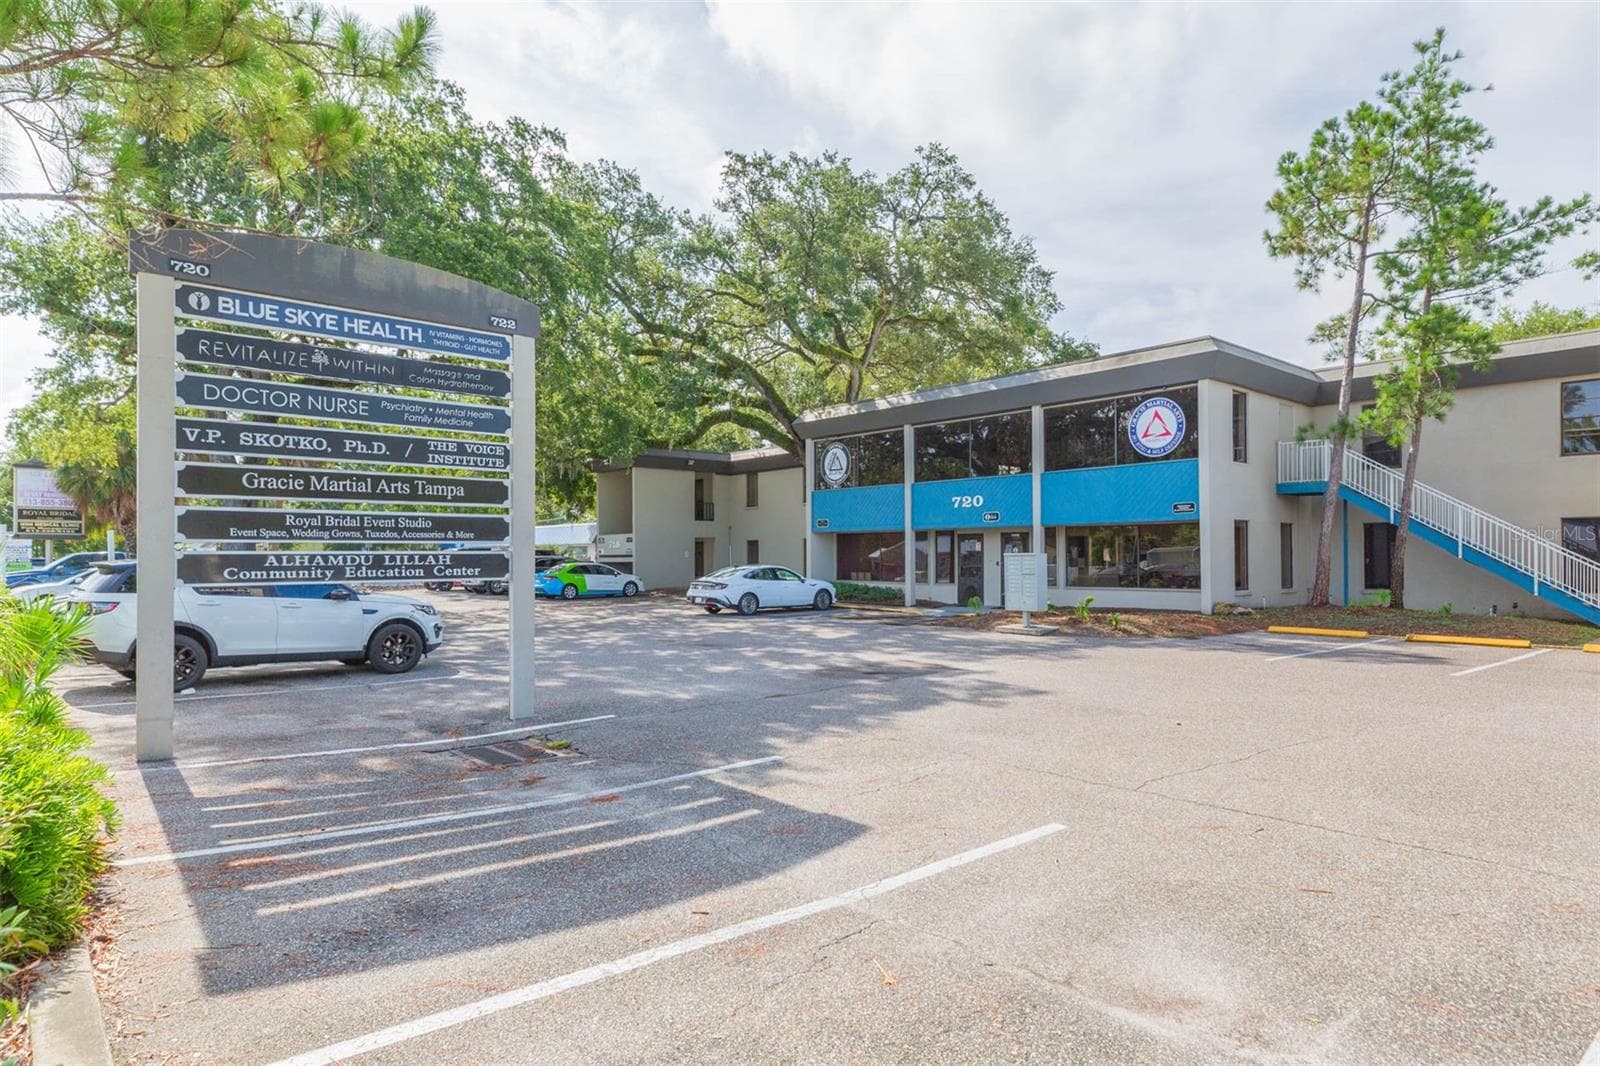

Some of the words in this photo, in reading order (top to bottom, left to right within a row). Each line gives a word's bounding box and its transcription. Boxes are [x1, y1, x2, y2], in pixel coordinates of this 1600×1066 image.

[170, 259, 210, 277] 720
[217, 296, 280, 321] BLUE
[284, 307, 339, 331] SKYE
[491, 316, 517, 330] 722
[433, 339, 460, 349] THYROID
[478, 345, 501, 354] HEALTH
[436, 331, 465, 342] VITAMINS
[469, 336, 503, 347] HORMONES
[198, 339, 308, 368] REVITALIZE
[332, 357, 395, 376] WITHIN
[423, 366, 462, 380] Massage
[463, 373, 481, 381] and
[408, 374, 436, 385] Colon
[437, 378, 494, 392] Hydrotherapy
[203, 383, 301, 409] DOCTOR
[308, 394, 369, 416] NURSE
[380, 400, 426, 413] Psychiatry
[435, 407, 465, 417] Mental
[466, 410, 494, 420] Health
[403, 412, 433, 425] Family
[433, 416, 474, 427] Medicine
[182, 427, 226, 444] V.P.
[239, 431, 332, 453] SKOTKO,
[343, 439, 390, 455] Ph.D.
[404, 443, 414, 458] /
[427, 440, 457, 452] THE
[464, 443, 505, 456] VOICE
[427, 453, 505, 468] INSTITUTE
[241, 472, 304, 490] Gracie
[309, 475, 372, 493] Martial
[376, 479, 410, 494] Arts
[414, 480, 465, 500] Tampa
[951, 494, 984, 509] 720
[285, 514, 321, 528] Royal
[325, 515, 360, 527] Bridal
[363, 516, 395, 528] Event
[398, 517, 432, 528] Studio
[229, 527, 257, 537] Event
[259, 528, 290, 538] Space,
[291, 528, 330, 538] Wedding
[331, 529, 363, 539] Gowns,
[364, 529, 401, 539] Tuxedos,
[401, 530, 445, 539] Accessories
[446, 531, 454, 539] &
[455, 531, 475, 539] More
[264, 555, 373, 567] ALHAMDU
[384, 554, 452, 566] LILLAH
[223, 566, 334, 581] Community
[344, 565, 424, 578] Education
[433, 565, 481, 576] Center
